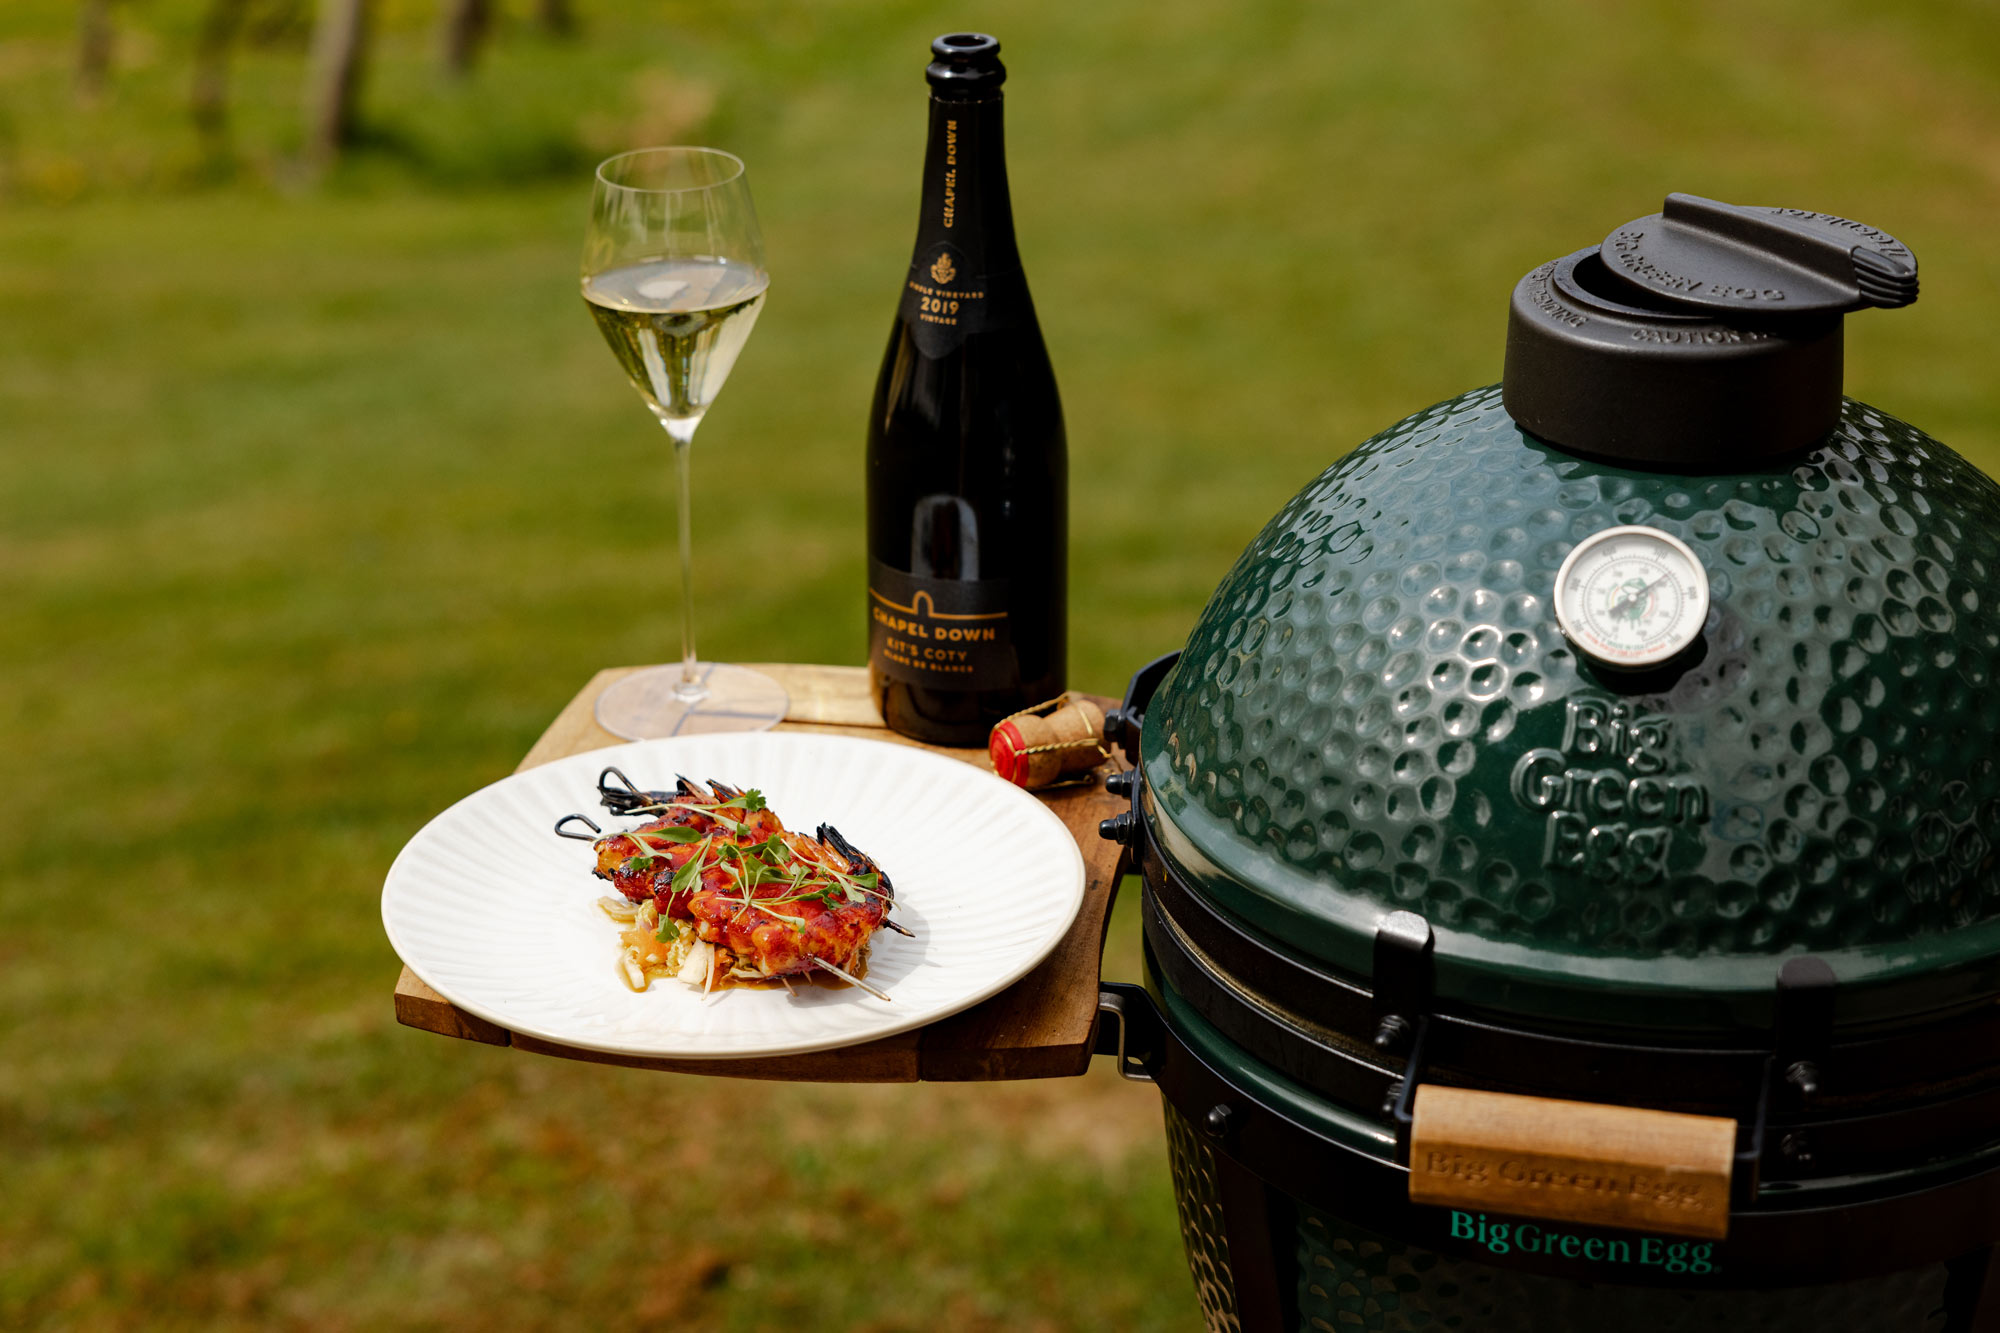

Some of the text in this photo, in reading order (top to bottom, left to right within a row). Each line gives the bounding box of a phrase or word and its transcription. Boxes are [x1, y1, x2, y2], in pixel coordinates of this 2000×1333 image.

[944, 120, 957, 228] CHAPEL DOWN
[920, 313, 957, 325] VINTAGE
[921, 296, 960, 315] 2019
[1630, 328, 1742, 347] CAUTION
[873, 607, 996, 642] CHAPEL DOWN
[886, 636, 968, 662] KIT'S COTY
[1561, 695, 1673, 773] Big
[1509, 747, 1710, 824] Green
[1542, 810, 1672, 880] Egg
[1426, 1150, 1491, 1187] Big
[1498, 1160, 1619, 1196] Green
[1450, 1209, 1511, 1254] Big
[1514, 1223, 1631, 1263] Green
